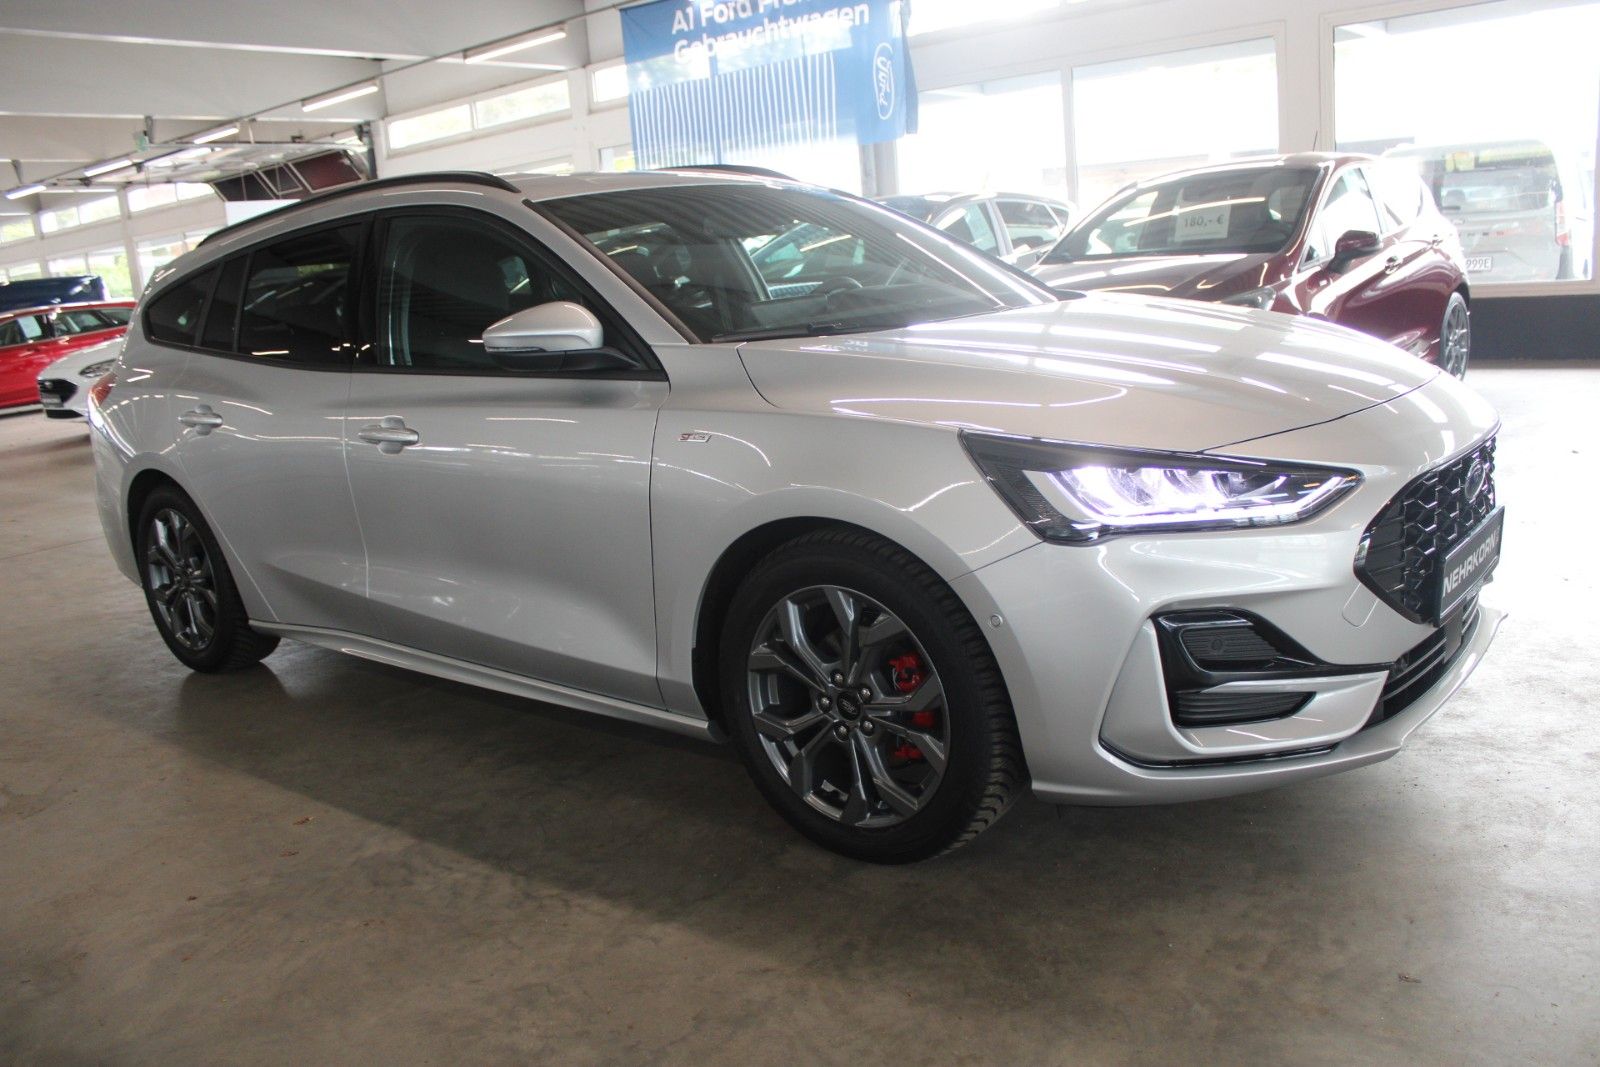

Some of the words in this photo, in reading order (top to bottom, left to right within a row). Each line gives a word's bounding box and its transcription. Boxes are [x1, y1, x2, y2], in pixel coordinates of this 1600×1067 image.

[672, 6, 694, 35] A1
[700, 0, 753, 27] Ford
[1442, 530, 1497, 597] NEHRKORN
